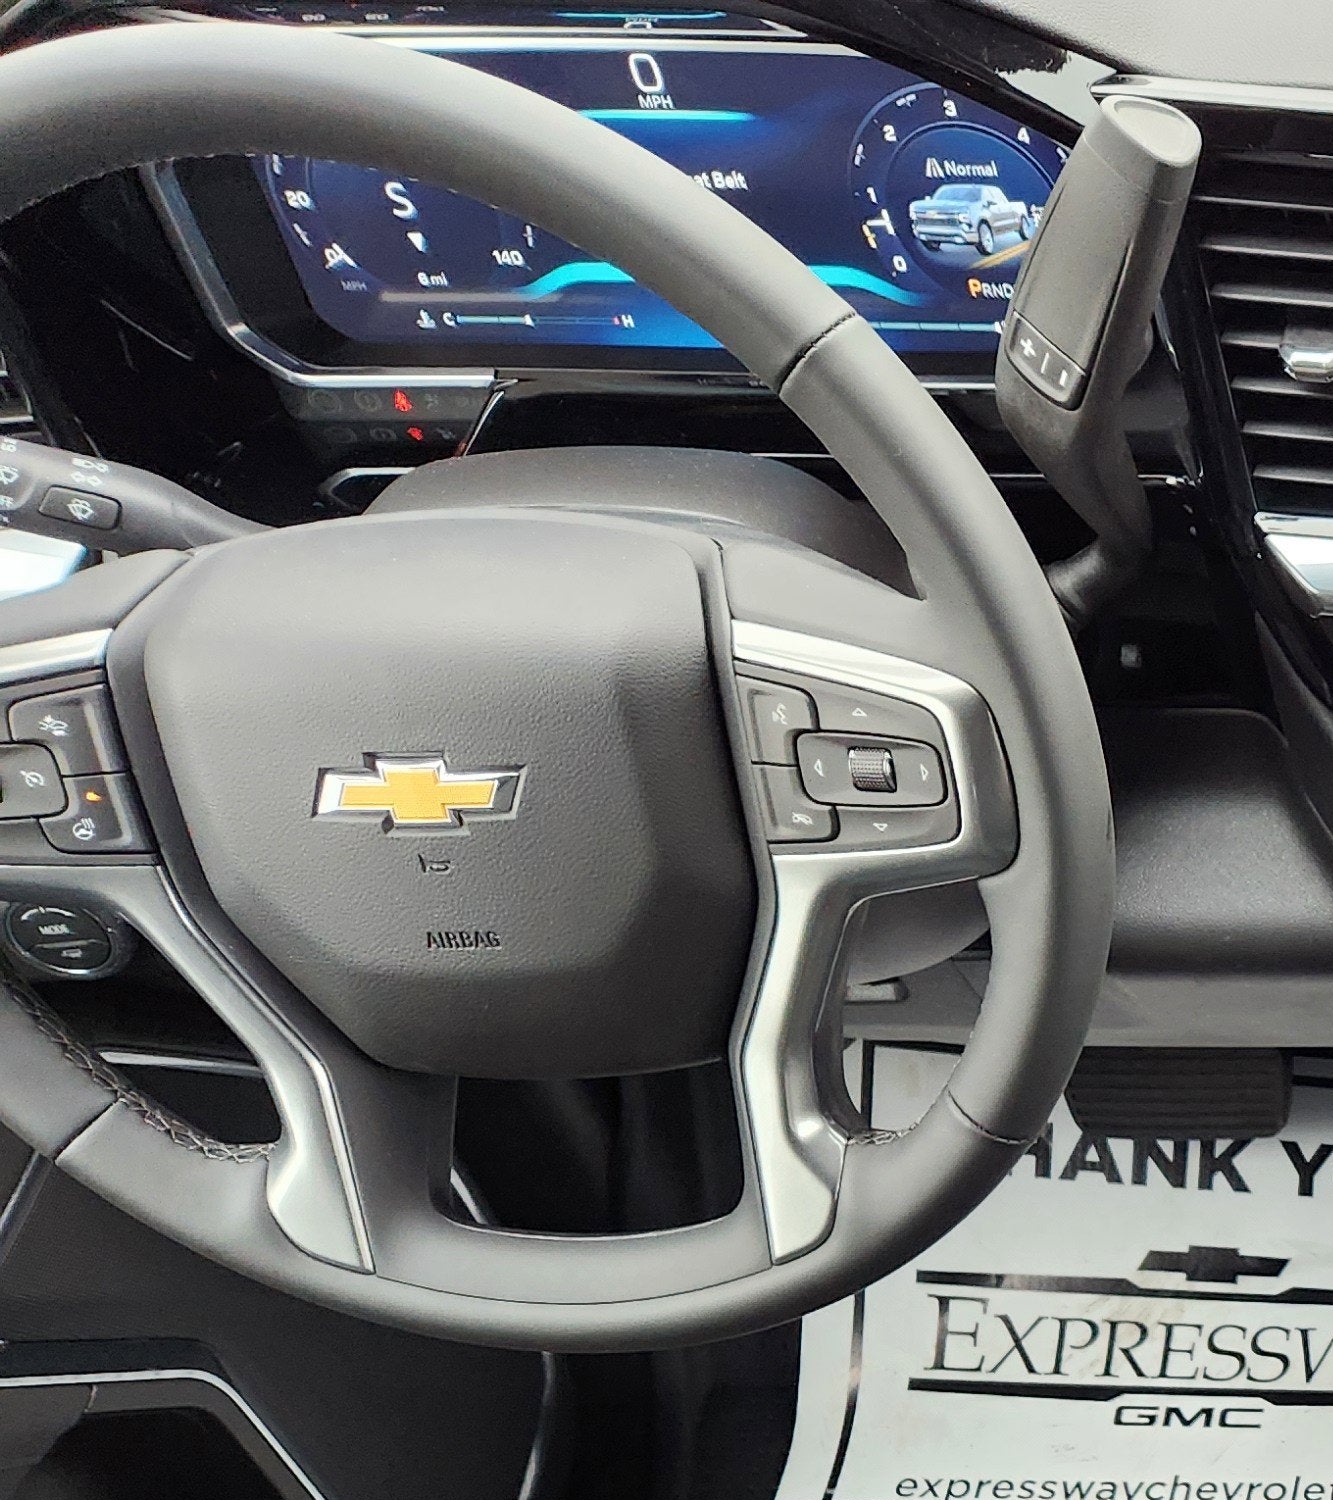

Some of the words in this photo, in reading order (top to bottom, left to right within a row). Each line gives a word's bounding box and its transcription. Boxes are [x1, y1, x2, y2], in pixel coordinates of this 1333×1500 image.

[627, 52, 665, 94] 0
[637, 93, 675, 110] MPH
[943, 100, 958, 117] 3
[882, 124, 897, 141] 2
[1017, 127, 1030, 145] 4
[943, 160, 999, 177] Normal
[711, 170, 749, 190] Belt
[283, 189, 314, 210] 20
[384, 180, 419, 220] S
[492, 249, 523, 267] 140
[892, 255, 907, 273] 0
[426, 931, 502, 949] AIRBAG
[1006, 1122, 1252, 1194] HANK
[1113, 1405, 1263, 1430] GMC
